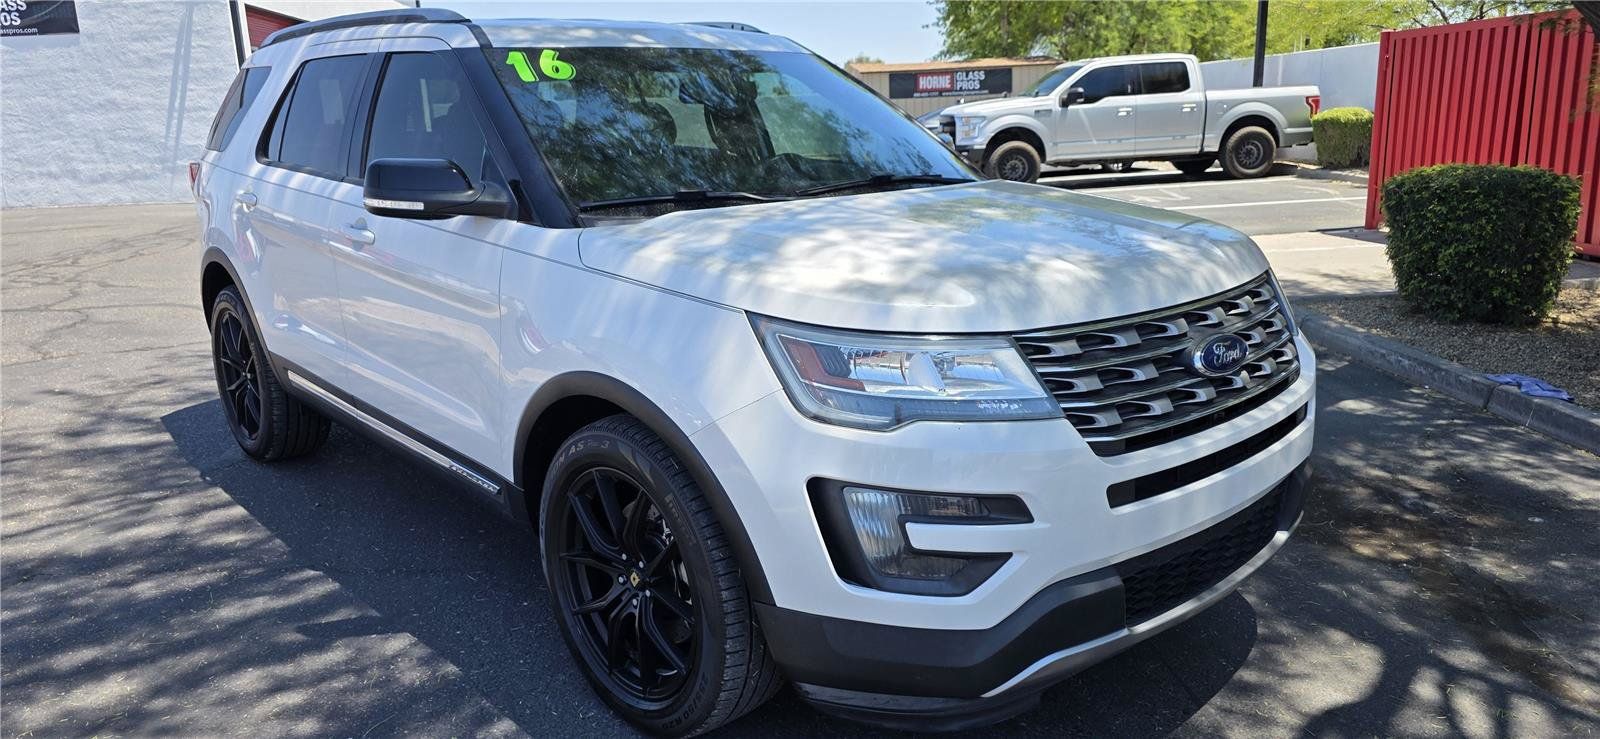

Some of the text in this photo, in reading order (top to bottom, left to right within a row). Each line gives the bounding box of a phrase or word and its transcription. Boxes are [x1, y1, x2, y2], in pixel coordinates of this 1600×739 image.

[0, 12, 21, 26] OS
[506, 49, 577, 82] 16
[919, 75, 951, 89] HORNE
[957, 71, 985, 80] GLASS
[956, 80, 981, 90] PROS
